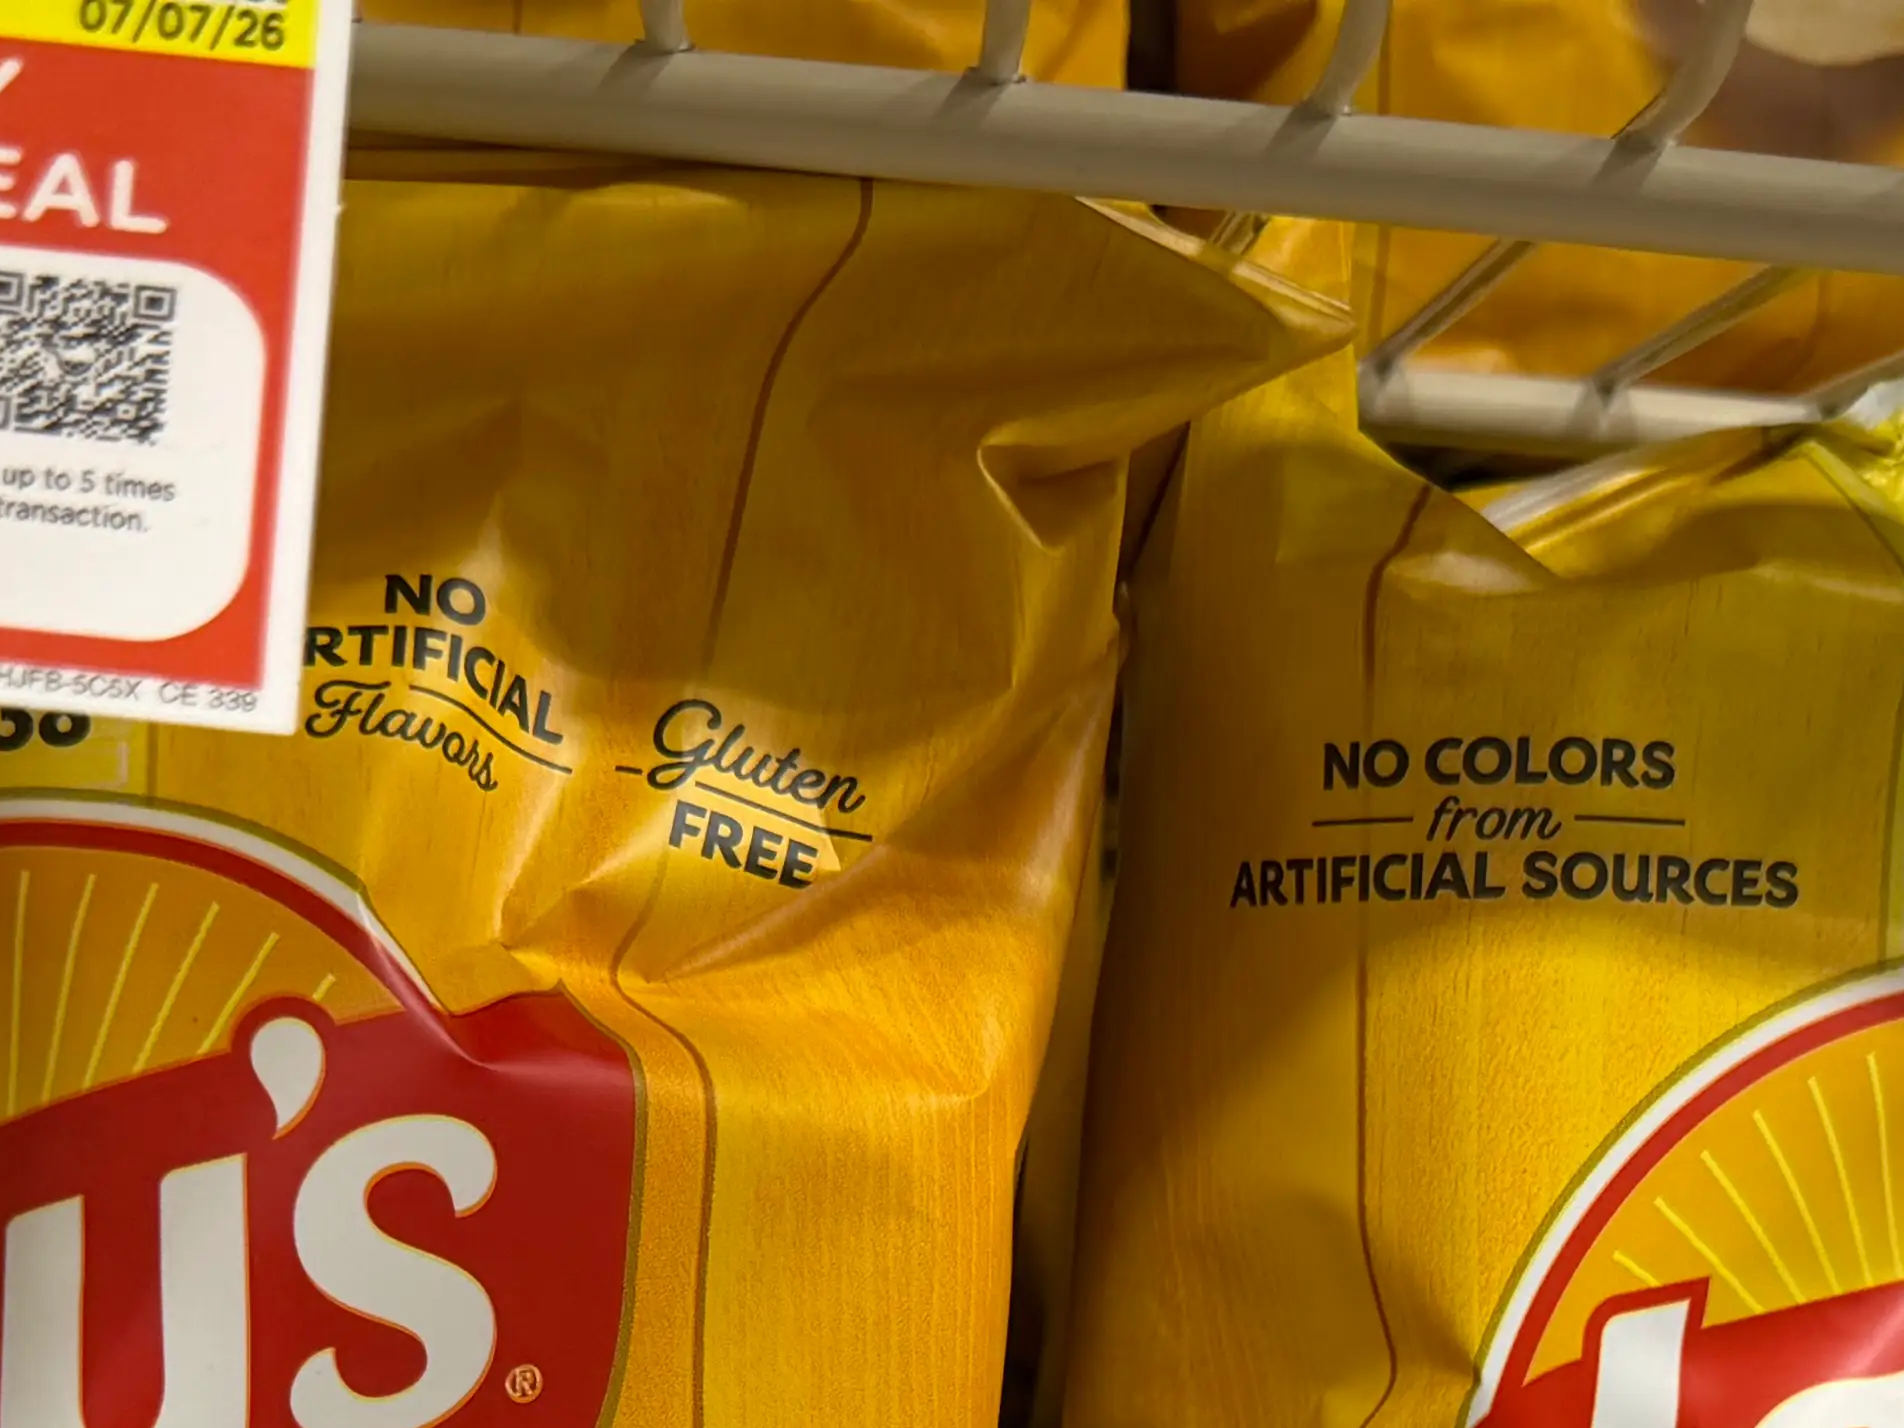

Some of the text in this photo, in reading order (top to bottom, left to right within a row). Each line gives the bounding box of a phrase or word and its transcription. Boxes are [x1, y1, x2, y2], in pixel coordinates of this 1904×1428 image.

[77, 0, 285, 52] 07/07/26
[2, 466, 36, 490] up
[45, 467, 72, 492] to
[79, 471, 96, 493] 5
[104, 473, 177, 502] times
[384, 573, 487, 626] NO
[302, 624, 565, 745] RTIFICIAL
[303, 680, 499, 792] Flavors
[646, 698, 866, 815] Gluten
[1322, 735, 1677, 791] NO COLORS
[668, 799, 820, 889] FREE
[1425, 795, 1563, 842] from
[1228, 850, 1801, 910] ARTIFICIAL SOURCES
